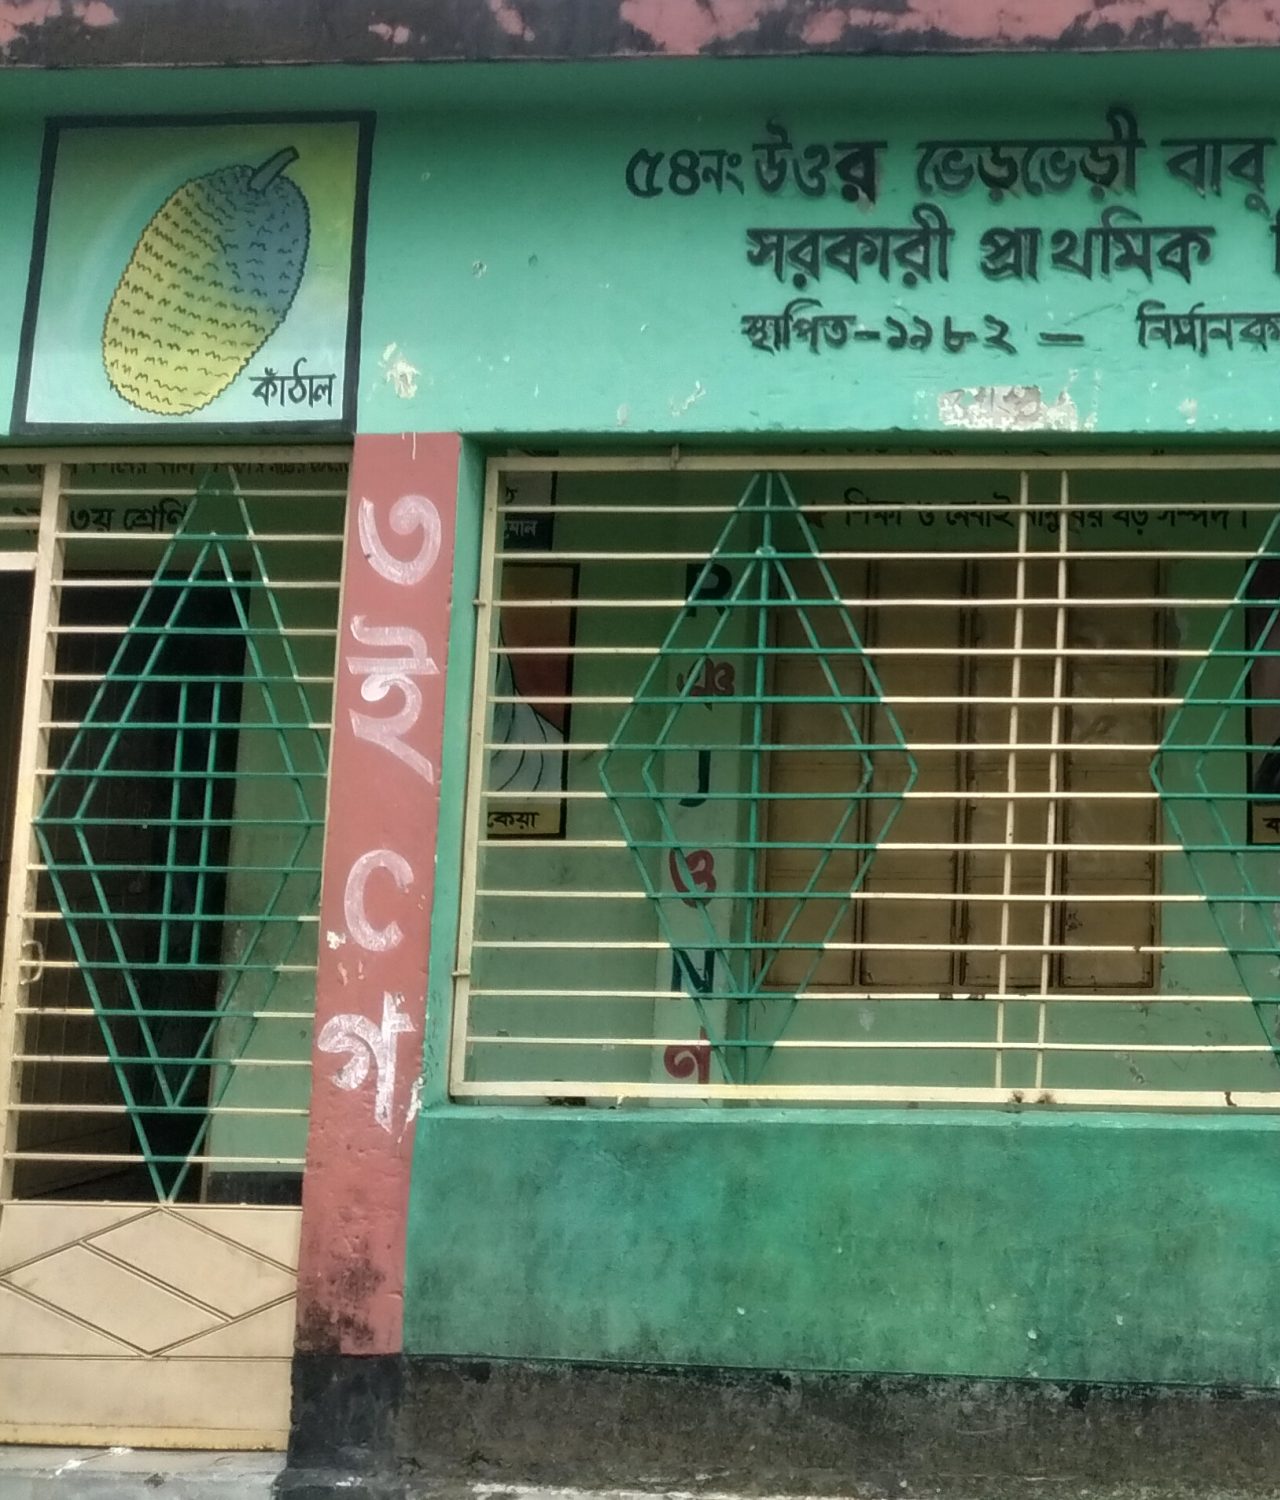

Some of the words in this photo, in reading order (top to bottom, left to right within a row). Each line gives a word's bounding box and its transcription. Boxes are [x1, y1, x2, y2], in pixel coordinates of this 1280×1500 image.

[1160, 137, 1278, 220] বাবু
[746, 203, 956, 291] সরকারী
[979, 205, 1217, 285] প্রাথমিক
[249, 357, 337, 408] কাঁঠাল
